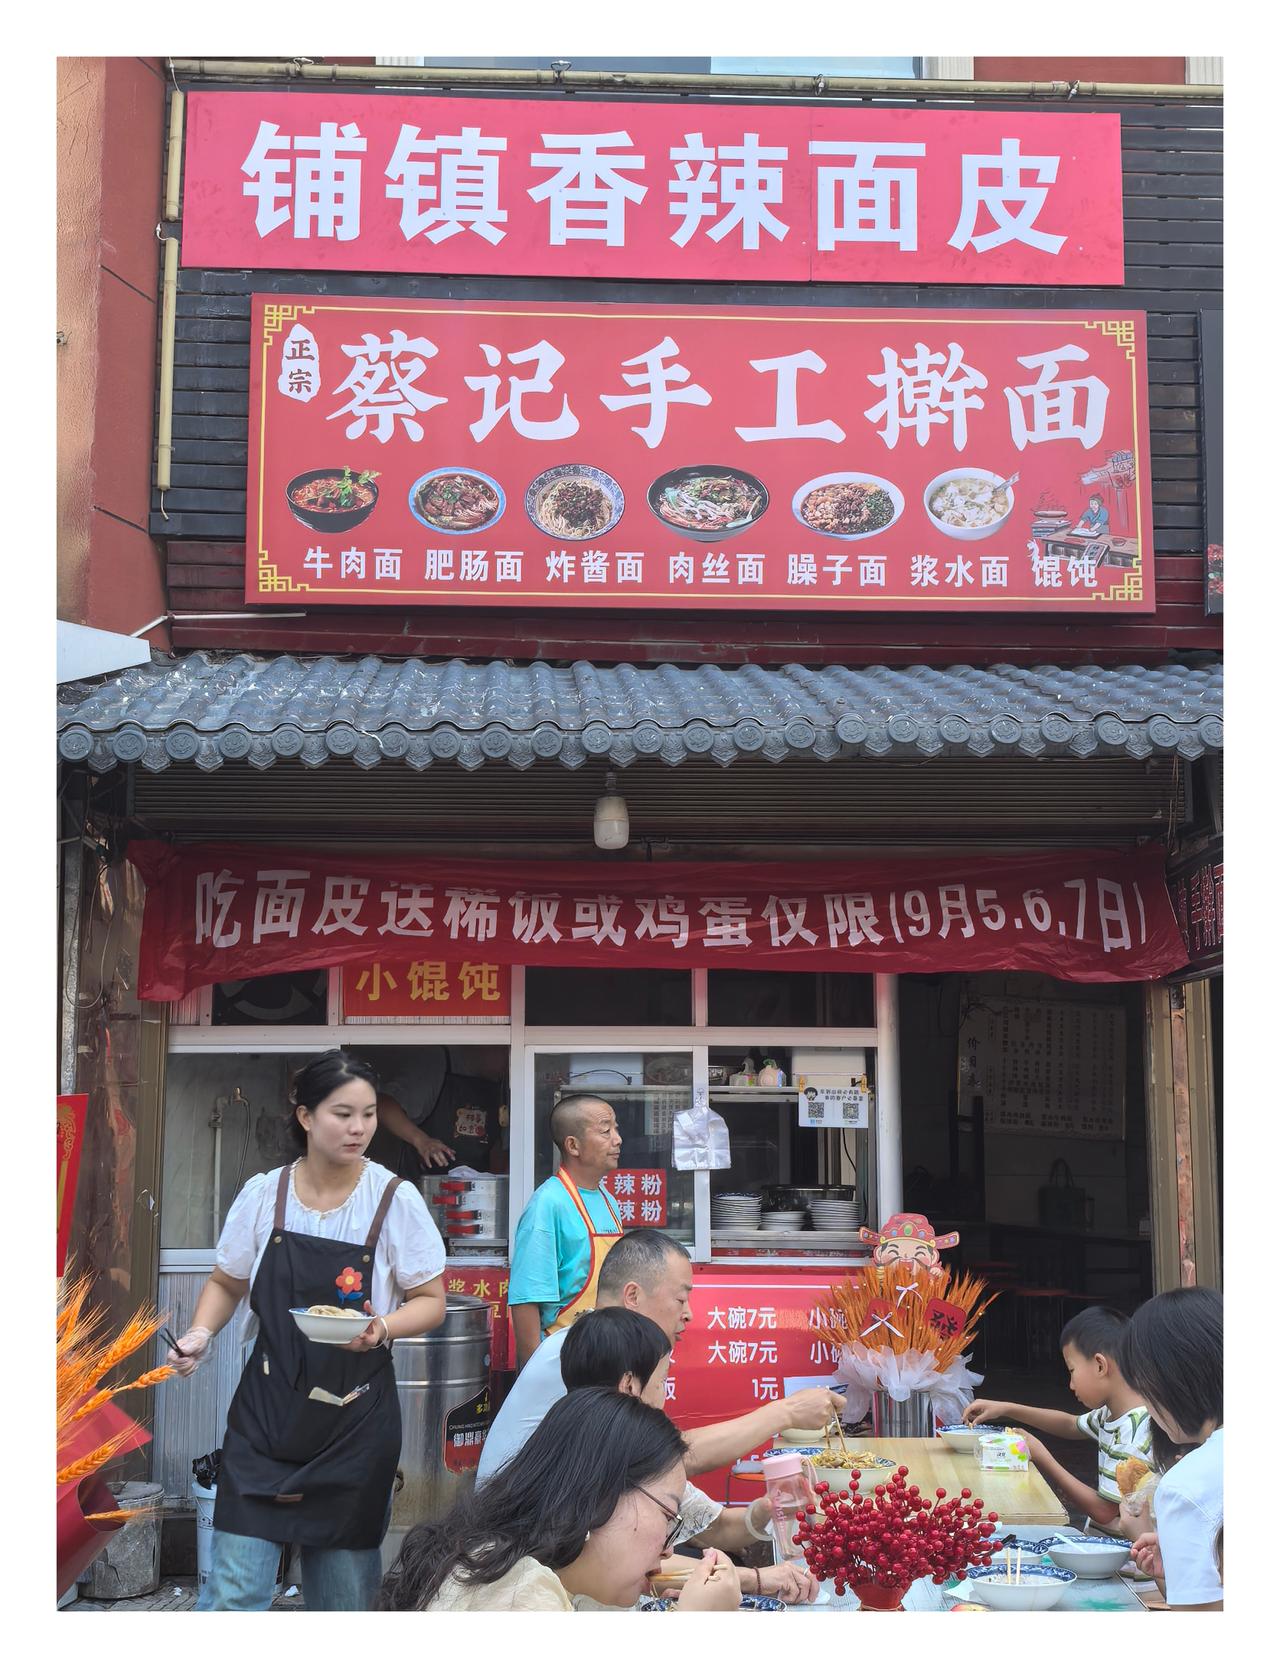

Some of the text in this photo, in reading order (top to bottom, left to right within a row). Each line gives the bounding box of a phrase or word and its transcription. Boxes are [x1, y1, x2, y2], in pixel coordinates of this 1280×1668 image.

[241, 121, 1068, 254] 铺镇香辣面皮
[284, 338, 315, 394] 正宗
[325, 329, 1110, 451] 蔡记手工擀面
[303, 546, 1098, 588] 牛肉面 肥肠面 炸酱面 肉丝面 臊子面 浆水面 馄饨
[355, 961, 501, 1001] 小馄饨
[707, 1306, 778, 1330] 大碗7元
[708, 1340, 778, 1364] 大碗7元
[752, 1378, 779, 1400] 1元
